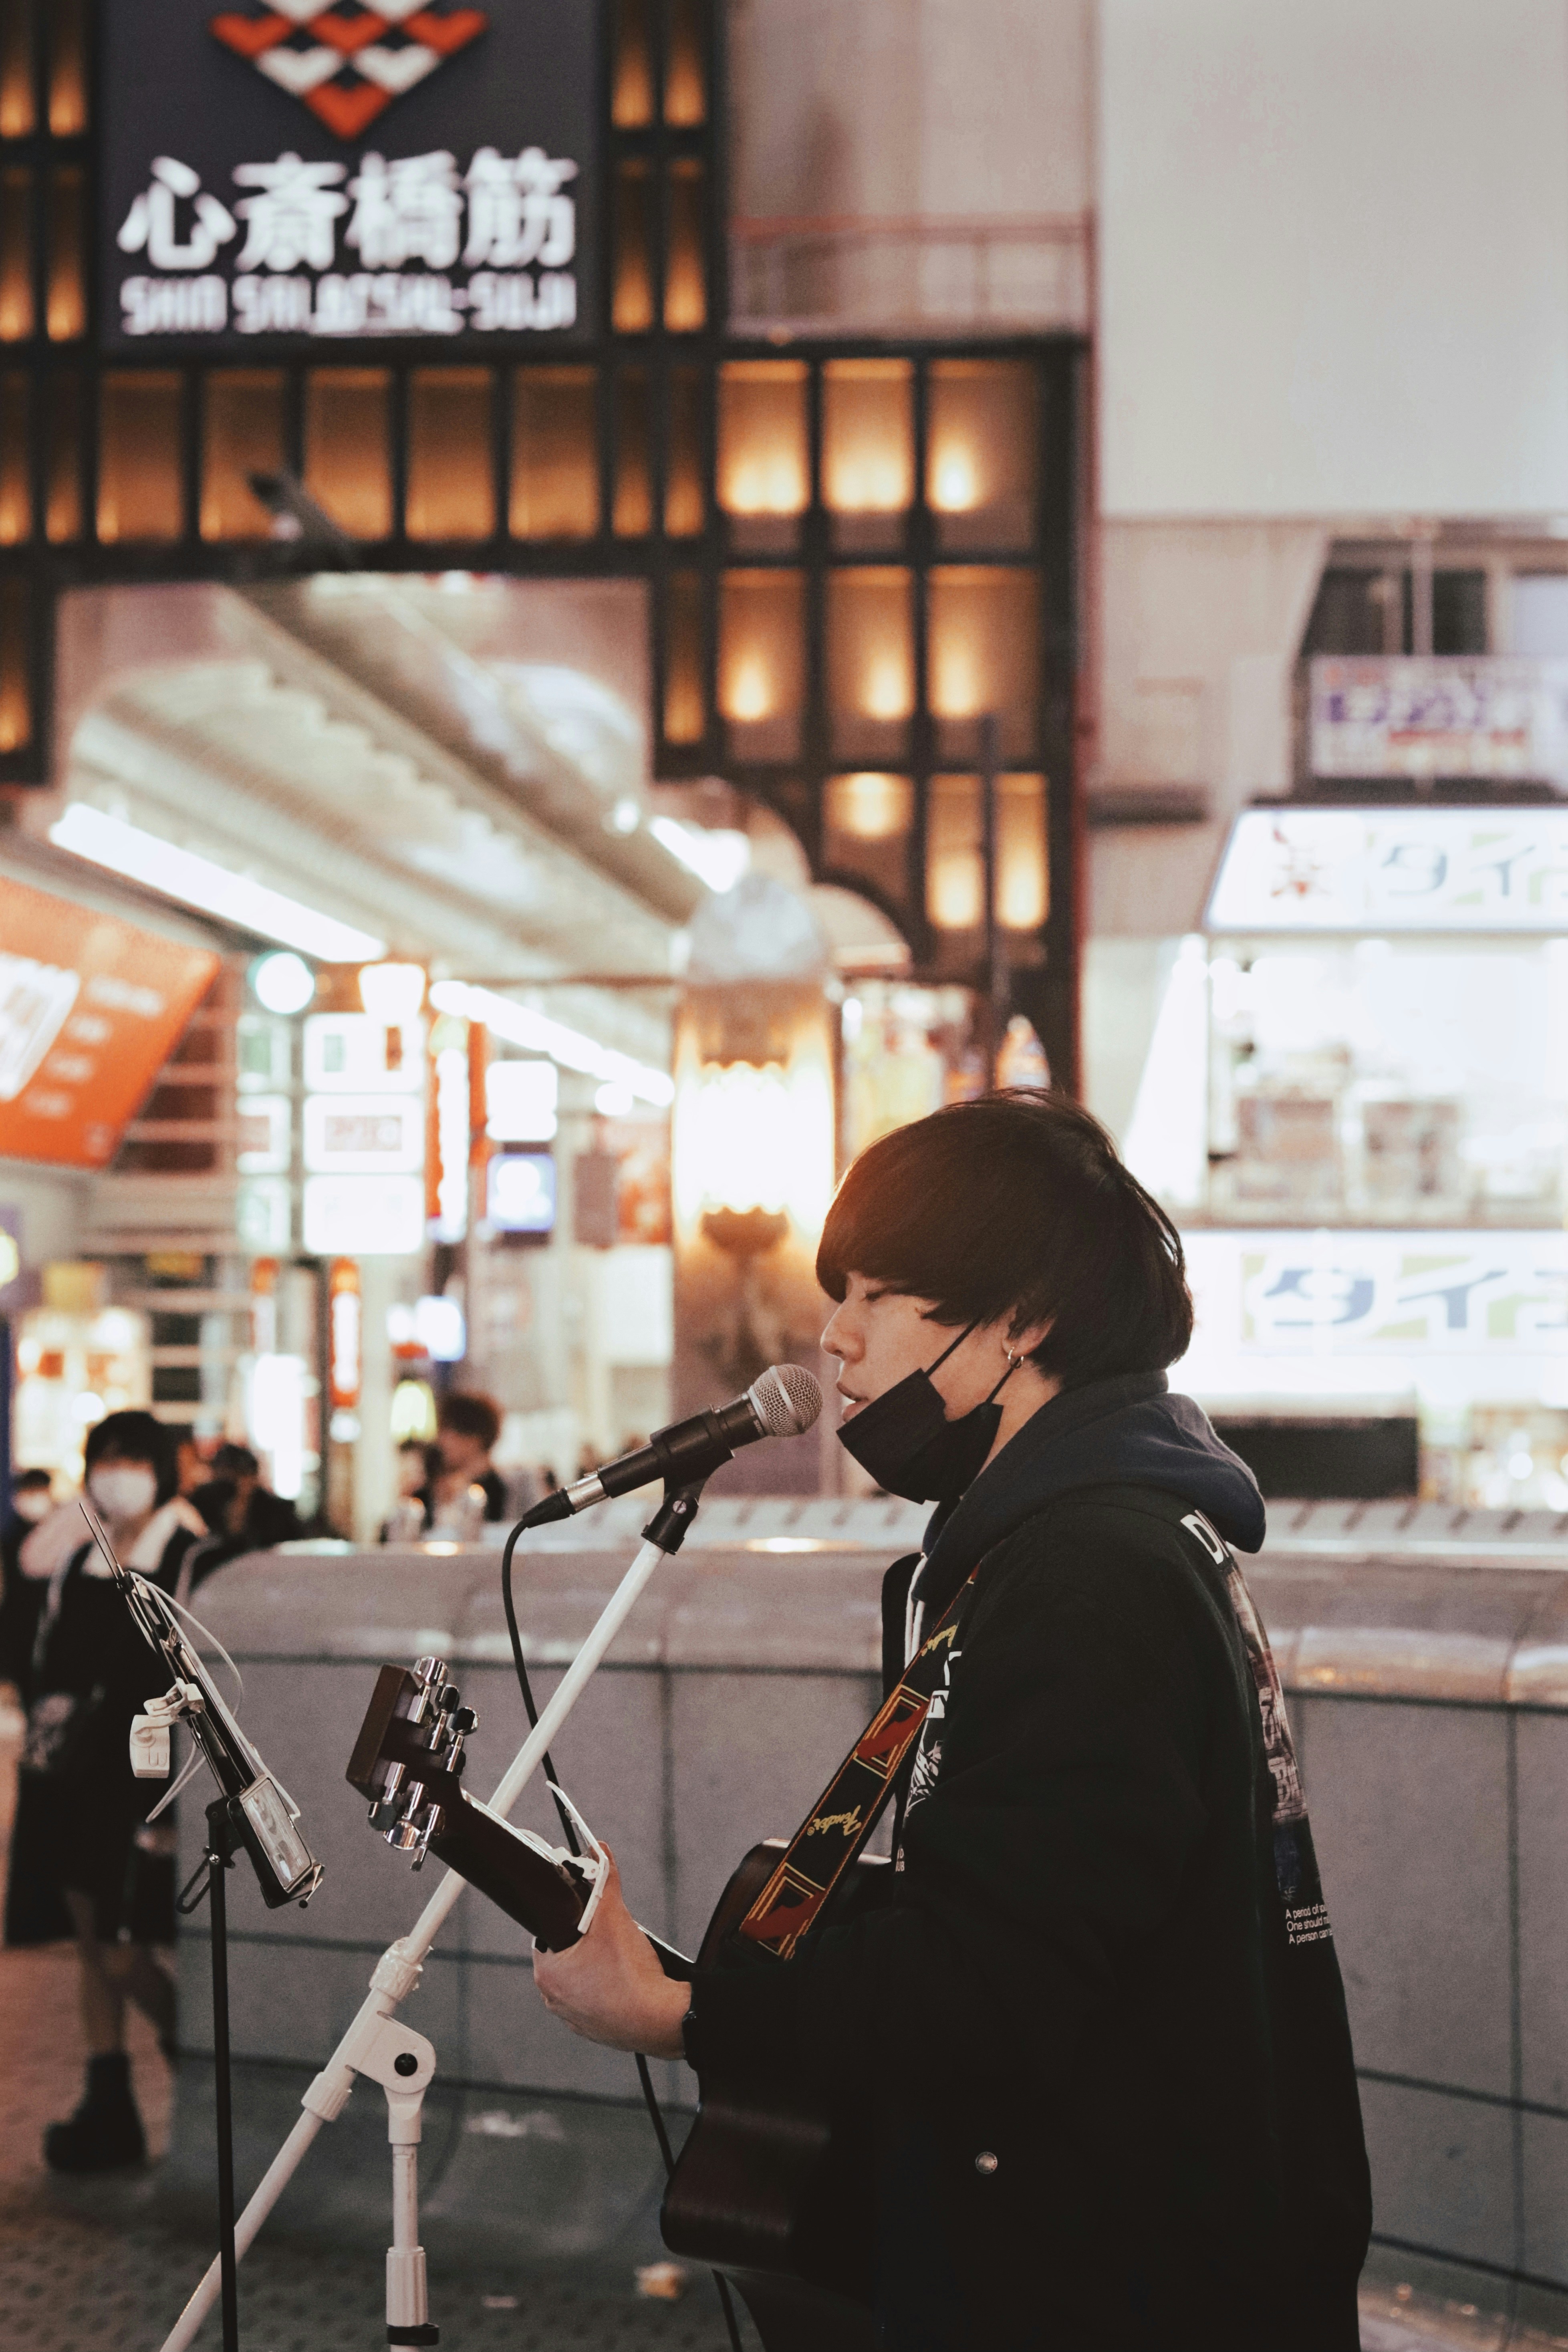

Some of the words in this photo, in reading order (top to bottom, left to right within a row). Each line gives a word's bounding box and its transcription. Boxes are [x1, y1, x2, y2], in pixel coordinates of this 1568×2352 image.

[117, 147, 577, 271] 心斎橋筋
[1286, 1909, 1292, 1919] A
[1293, 1906, 1311, 1920] period
[1312, 1904, 1319, 1915] of
[1287, 1921, 1303, 1931] One
[1304, 1916, 1323, 1929] should
[1289, 1934, 1295, 1944] A
[1296, 1931, 1318, 1945] person
